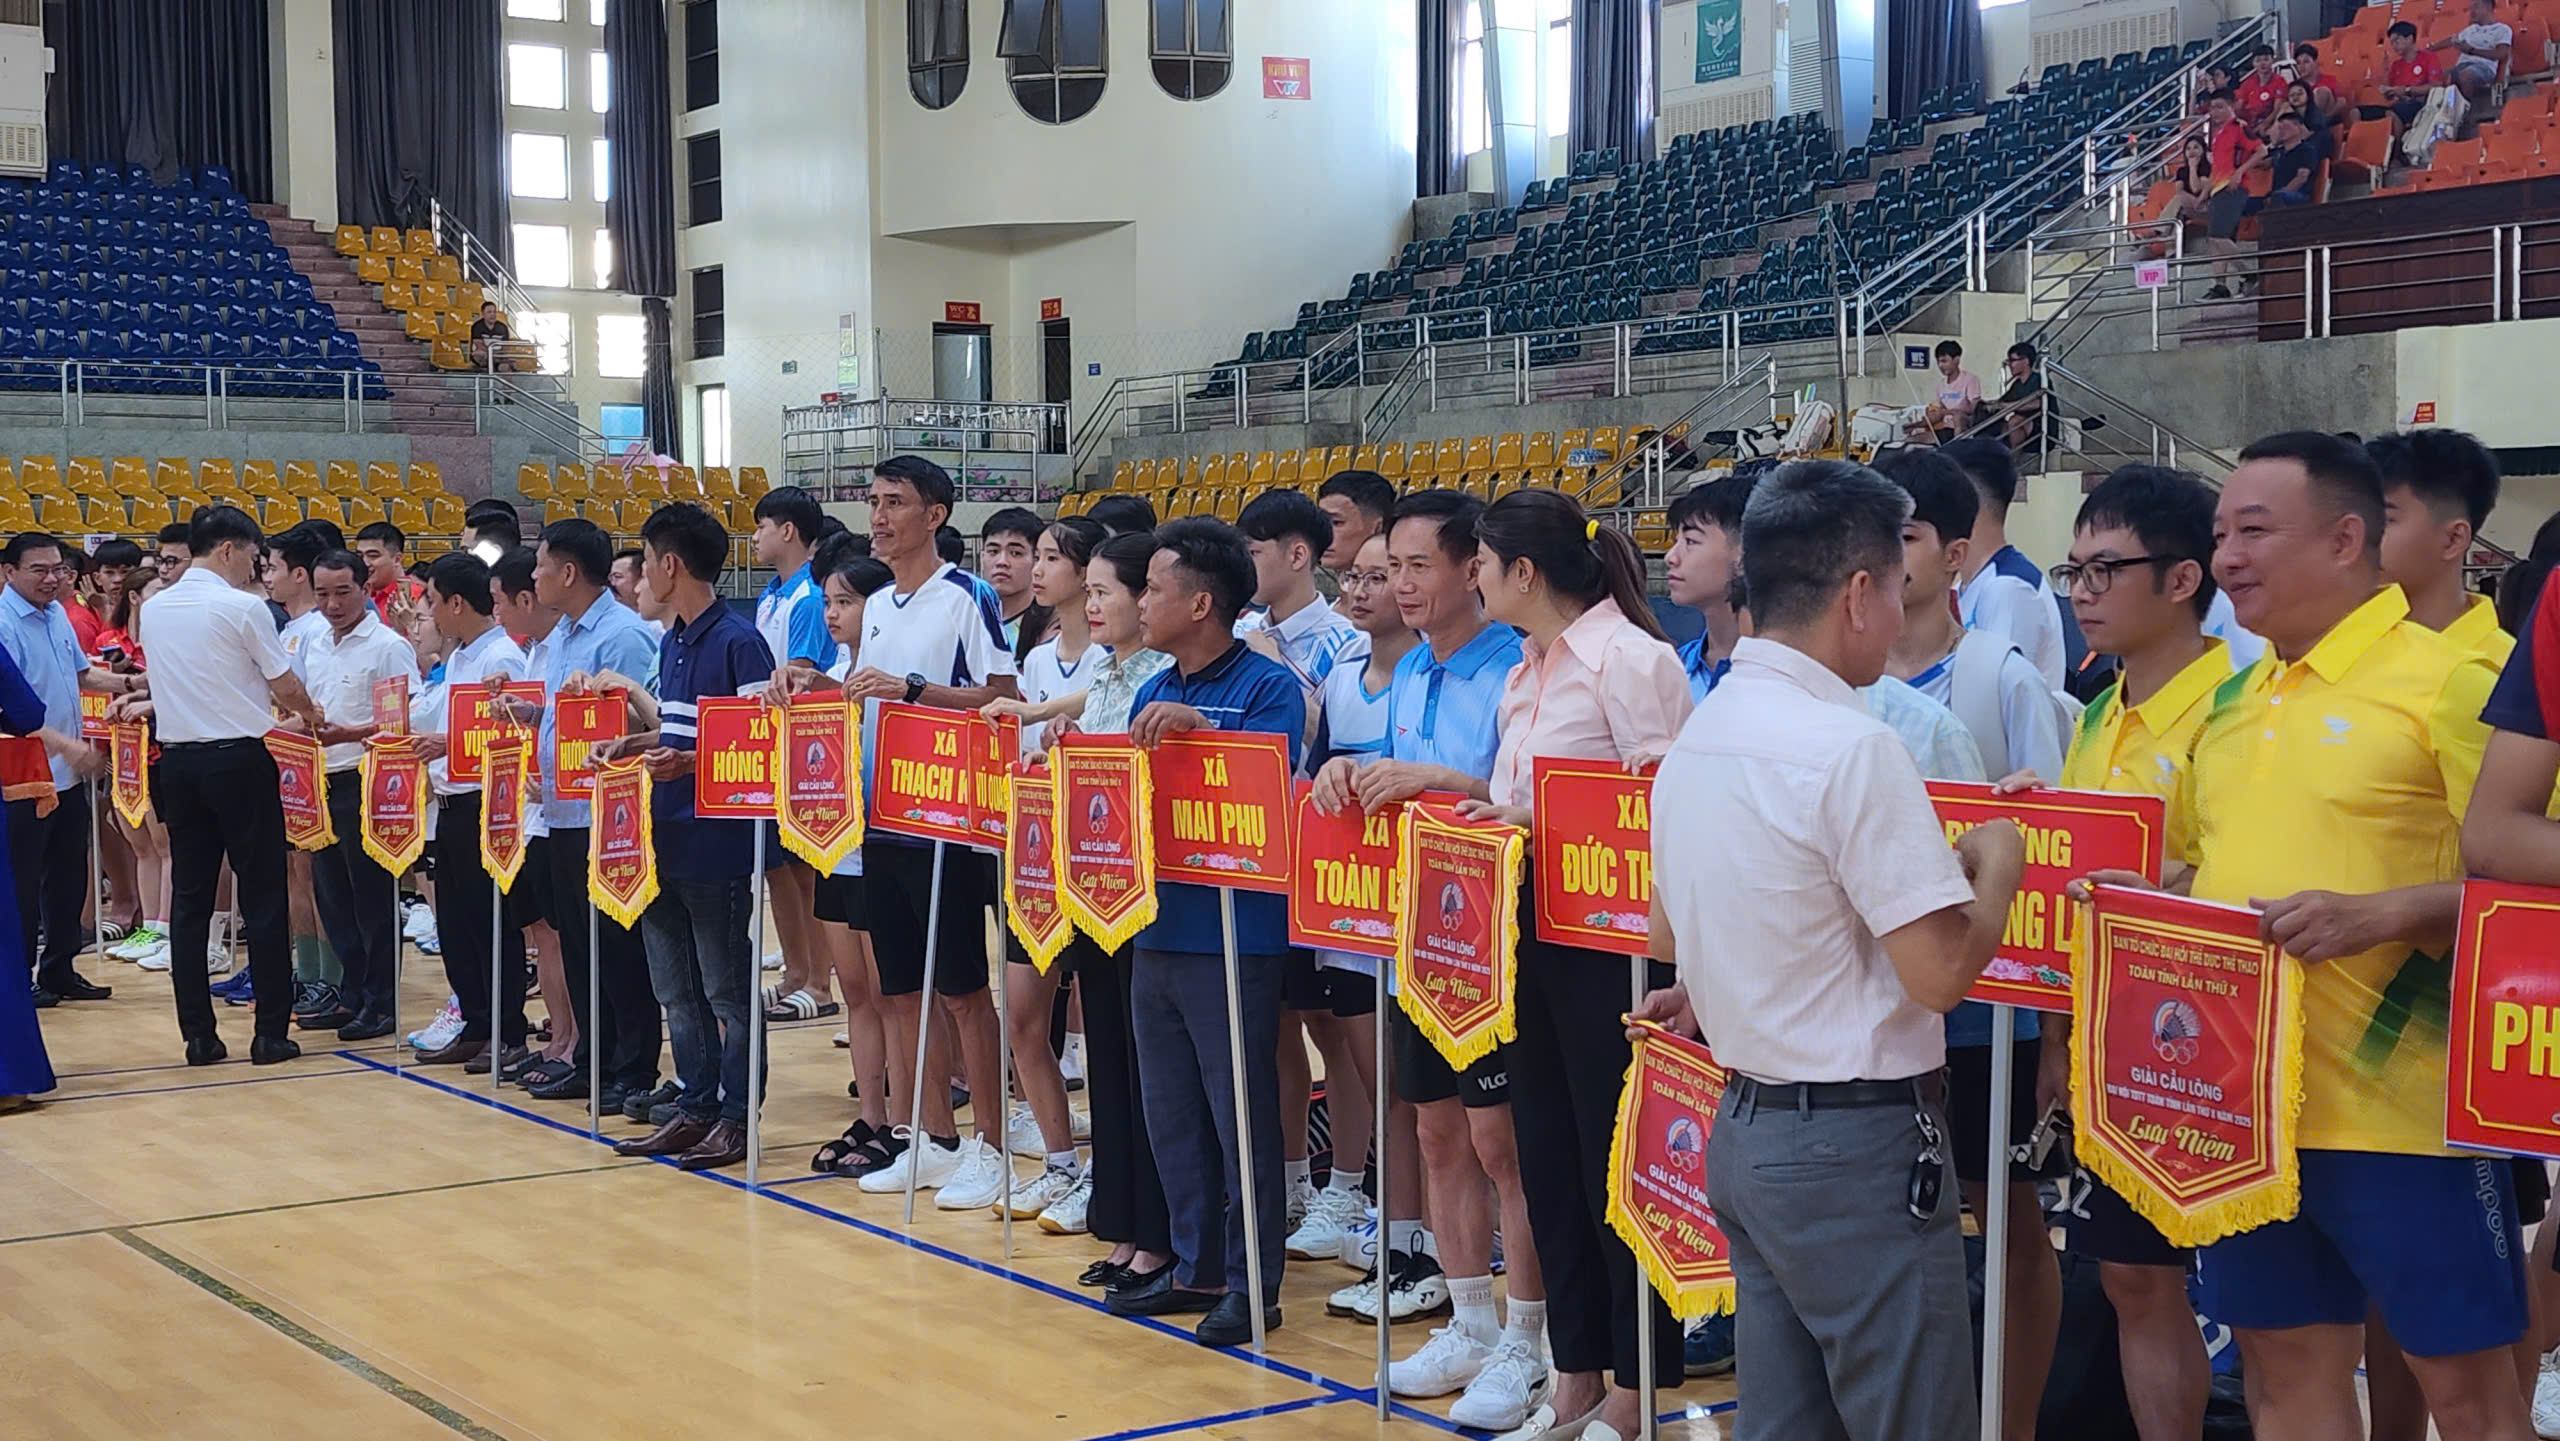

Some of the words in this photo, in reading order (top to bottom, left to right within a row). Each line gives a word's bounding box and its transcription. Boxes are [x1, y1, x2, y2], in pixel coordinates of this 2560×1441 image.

[2144, 271, 2159, 282] VIP
[1911, 352, 1925, 363] WC
[749, 713, 770, 740] XÃ
[933, 728, 957, 757] XÃ
[713, 740, 764, 783] HỒNG
[1203, 753, 1229, 788] XÃ
[891, 758, 954, 805] THẠCH
[1172, 799, 1216, 843] MAI
[1220, 802, 1267, 857] PHỤ
[1617, 789, 1649, 831] XÃ
[1362, 811, 1390, 848] XÃ
[1079, 871, 1097, 889] Lưu
[1100, 873, 1128, 893] Niệm
[1314, 853, 1380, 911] TOÀN
[1562, 834, 1617, 898] ĐỨC
[1427, 932, 1440, 949] GIẢI
[1441, 934, 1455, 952] CẦU
[1457, 939, 1476, 957] LÔNG
[2113, 935, 2128, 950] BAN
[2128, 935, 2139, 952] TỔ
[2140, 939, 2160, 957] CHỨC
[2238, 959, 2260, 976] THAO
[1424, 971, 1447, 992] Lưu
[1450, 976, 1481, 1003] Niệm
[2128, 964, 2155, 982] TOÀN
[2157, 968, 2179, 987] TỈNH
[2181, 971, 2202, 991] LẦN
[2205, 978, 2228, 996] THỨ
[2230, 984, 2239, 997] X
[2491, 1001, 2560, 1078] PH
[1652, 1080, 1675, 1099] TOÀN
[1675, 1088, 1695, 1109] TỈNH
[1695, 1098, 1711, 1117] LẦN
[2131, 1064, 2157, 1086] GIẢI
[2160, 1069, 2186, 1093] CẦU
[2189, 1077, 2223, 1102] LÔNG
[2127, 1115, 2169, 1145] Lưu
[2174, 1125, 2236, 1162] Niệm
[1648, 1163, 1667, 1182] GIẢI
[1668, 1173, 1688, 1195] CẦU
[1643, 1202, 1673, 1231] Lưu
[1676, 1220, 1716, 1257] Niệm
